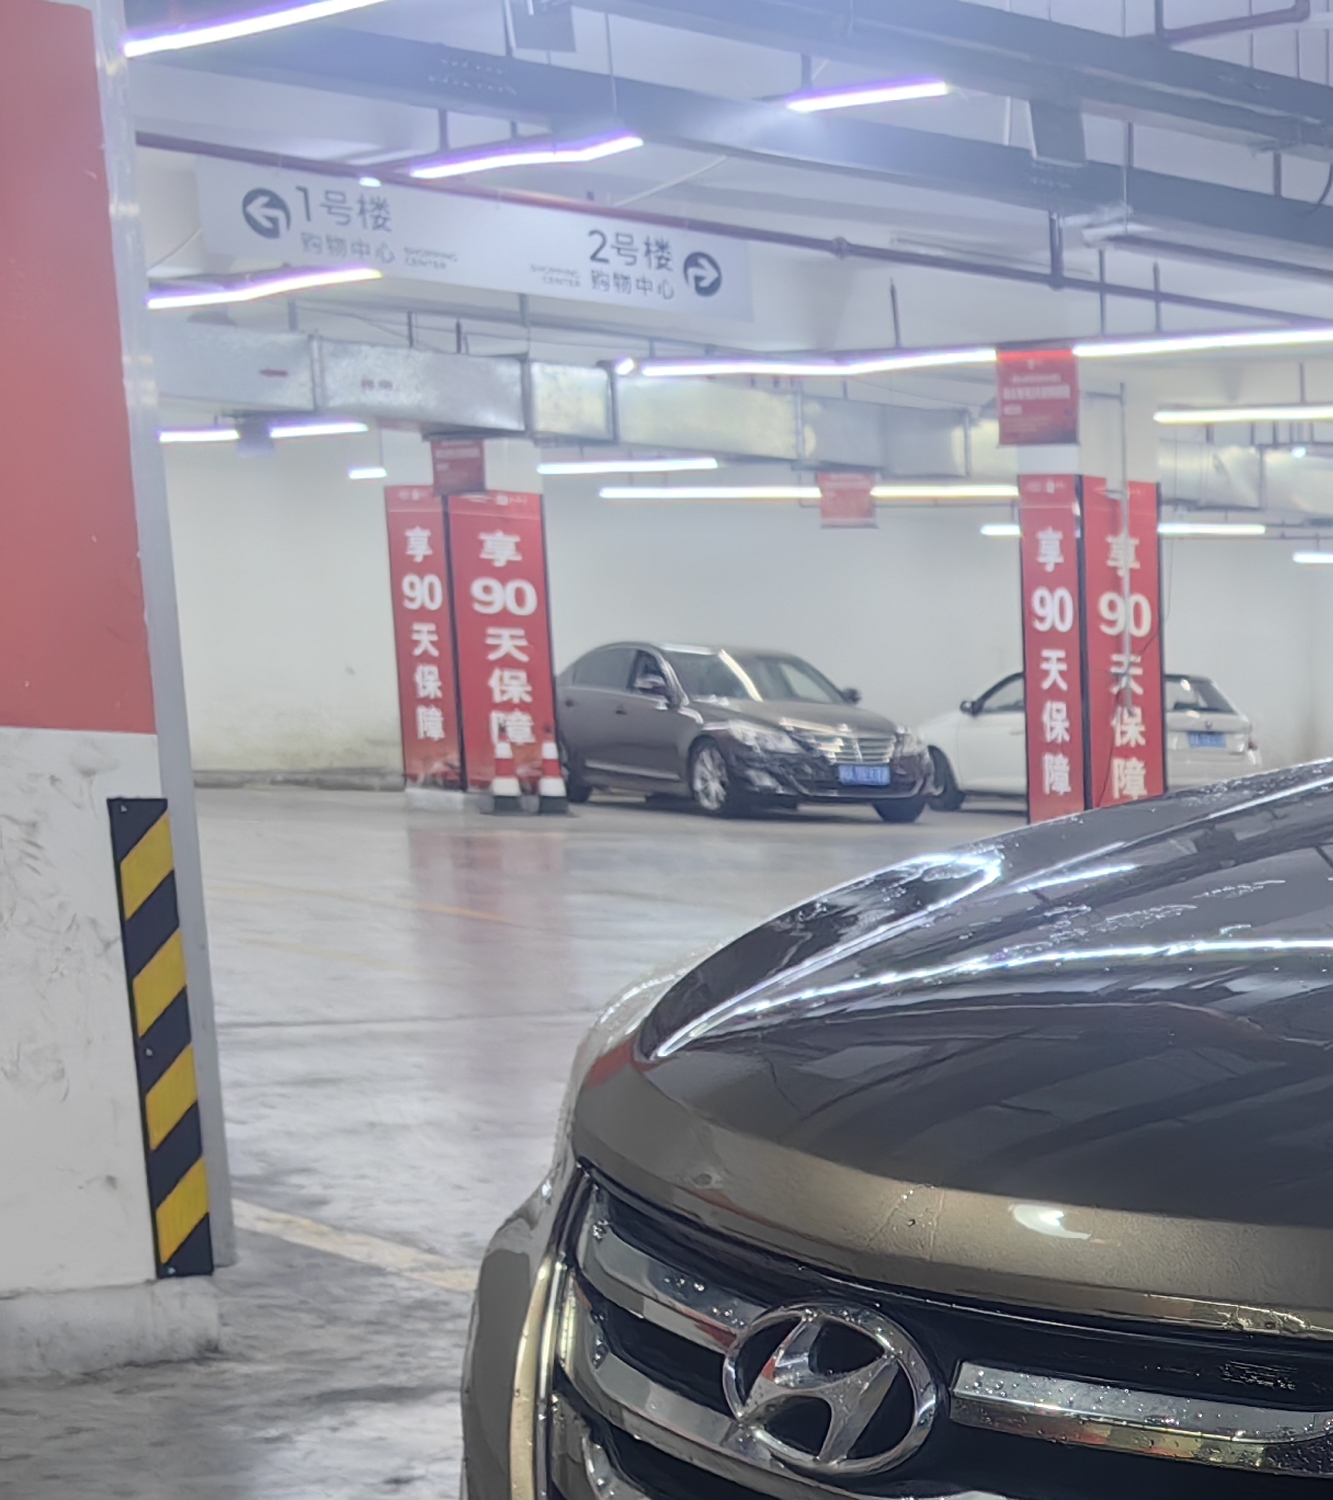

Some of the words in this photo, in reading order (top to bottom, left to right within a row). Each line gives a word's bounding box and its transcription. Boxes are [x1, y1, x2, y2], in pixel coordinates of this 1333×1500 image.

[295, 185, 392, 233] 1号楼
[301, 232, 395, 264] 购物中心
[588, 229, 673, 272] 2号楼
[591, 269, 675, 300] 购物中心
